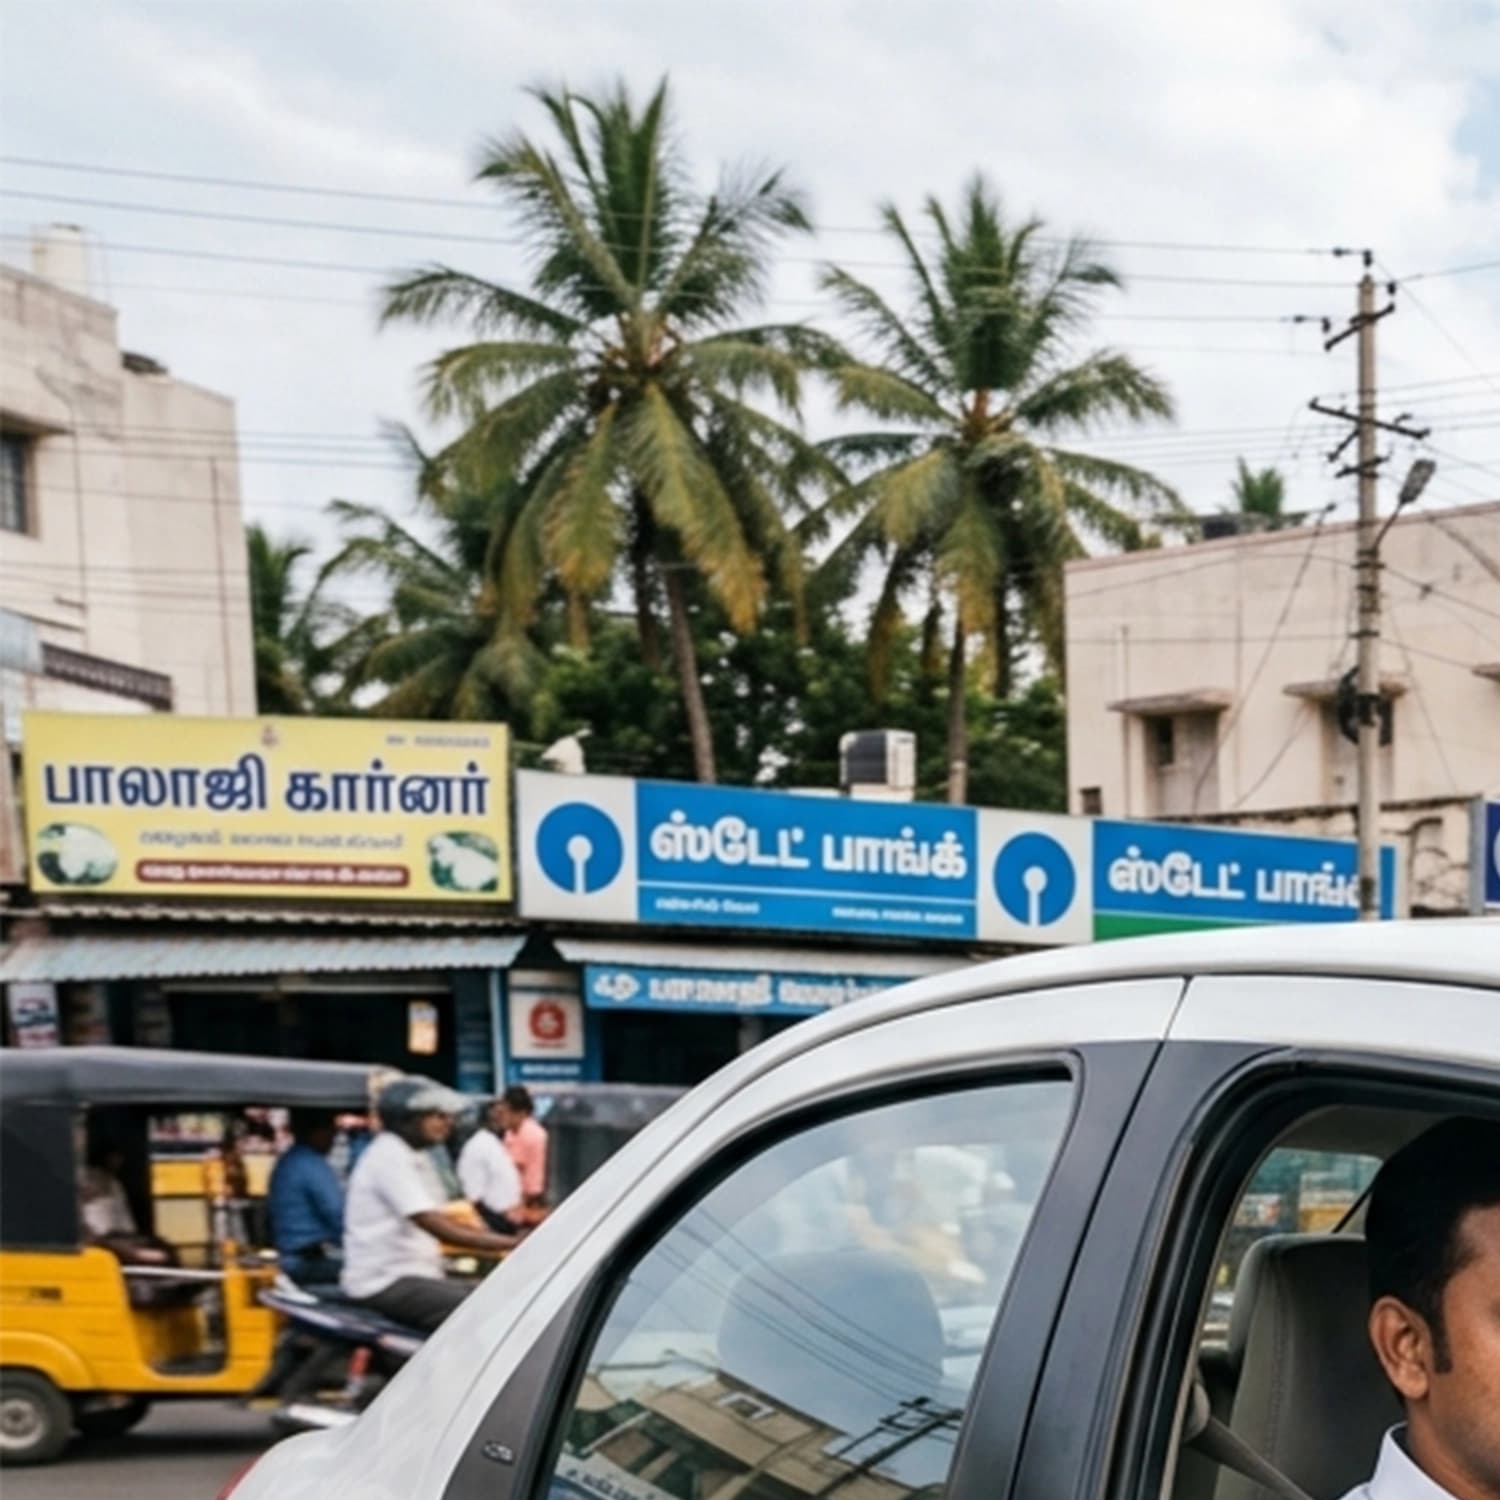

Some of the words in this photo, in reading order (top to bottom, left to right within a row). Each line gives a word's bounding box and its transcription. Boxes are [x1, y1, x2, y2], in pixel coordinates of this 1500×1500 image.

[44, 753, 267, 811] பாலாஜி
[285, 759, 490, 816] கார்னர்
[650, 809, 810, 869] ஸ்டேட்
[823, 826, 968, 880] பாங்க்
[1108, 845, 1246, 900] ஸ்டேட்
